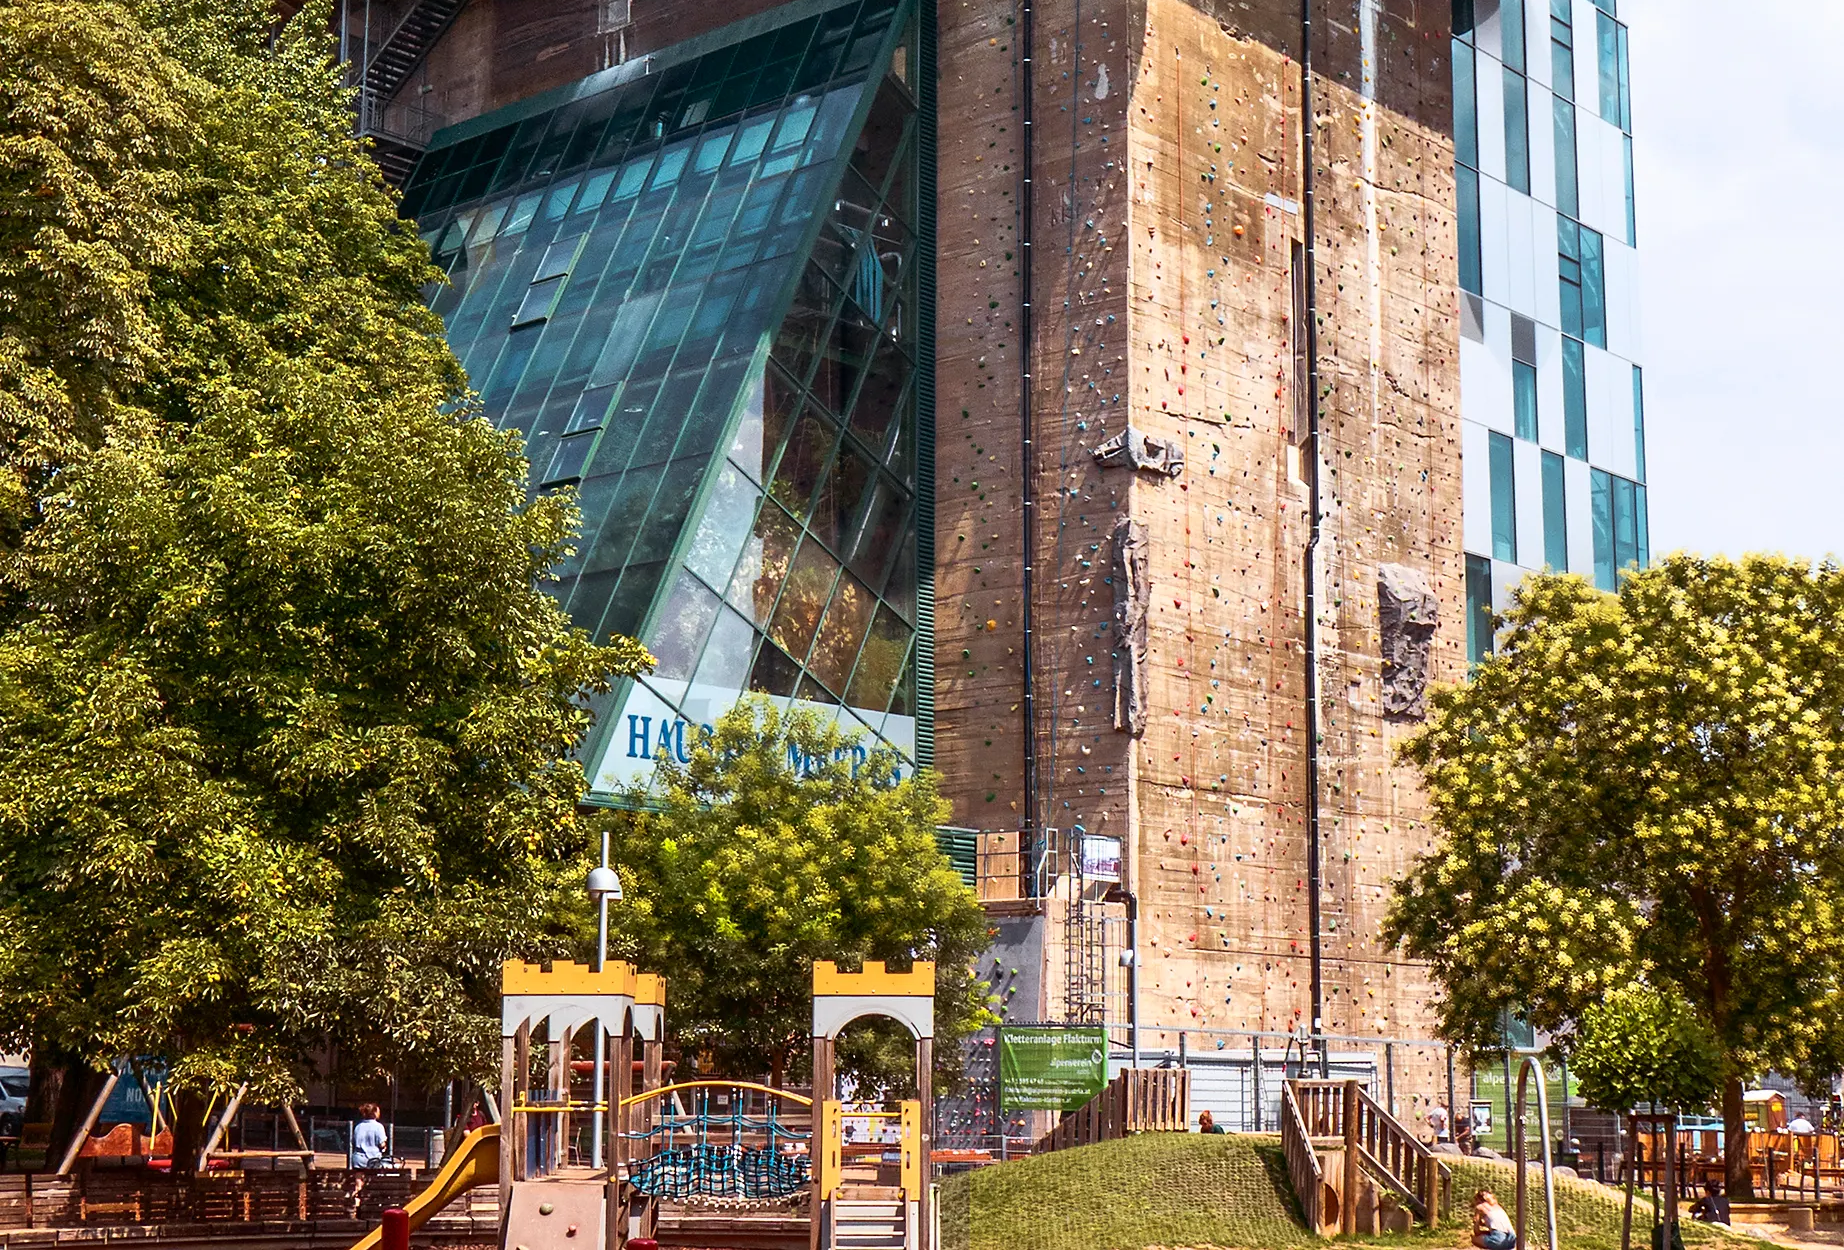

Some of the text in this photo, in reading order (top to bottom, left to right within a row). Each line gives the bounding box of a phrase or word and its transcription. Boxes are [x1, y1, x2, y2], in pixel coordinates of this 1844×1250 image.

[1004, 1033, 1103, 1046] Kletteranlage Flakturm
[1049, 1057, 1092, 1068] alpenverein
